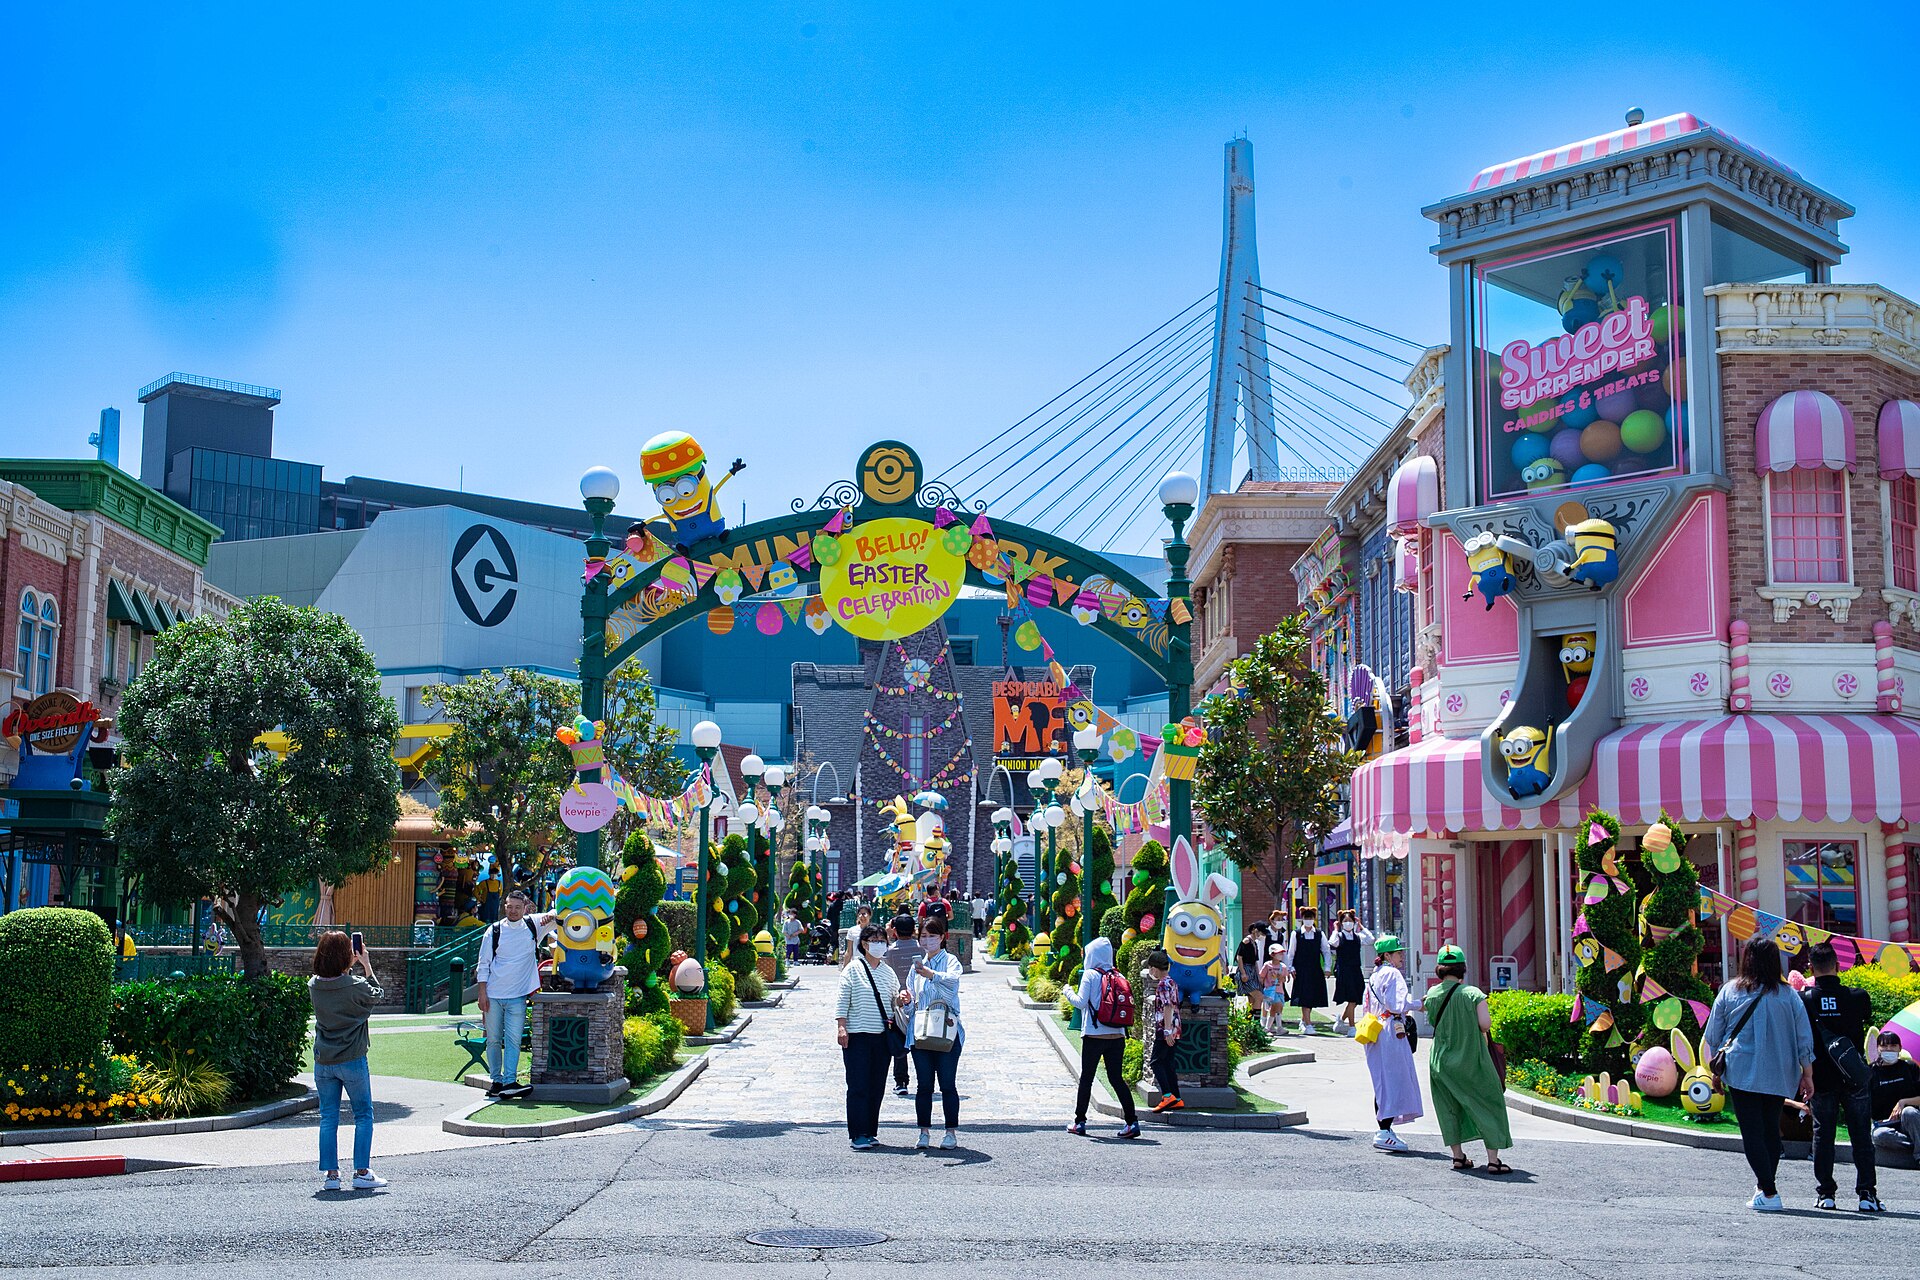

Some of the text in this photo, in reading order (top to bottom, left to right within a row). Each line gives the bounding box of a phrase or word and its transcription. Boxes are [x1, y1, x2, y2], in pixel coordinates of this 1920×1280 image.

[1502, 297, 1652, 388] Sweet
[1502, 340, 1654, 408] SURRENDER
[1503, 369, 1660, 433] CANDIES & TREATS
[856, 529, 929, 562] BELLO!
[848, 563, 930, 590] EASTER
[837, 580, 951, 620] CELEBRATION
[992, 681, 1062, 697] DESPICABL
[2, 701, 101, 738] Overalls
[29, 725, 79, 742] ONE SIZE FITS ALL
[993, 697, 1068, 752] ME
[997, 759, 1027, 770] MINION
[565, 806, 601, 818] kewpie
[1821, 997, 1836, 1010] 65
